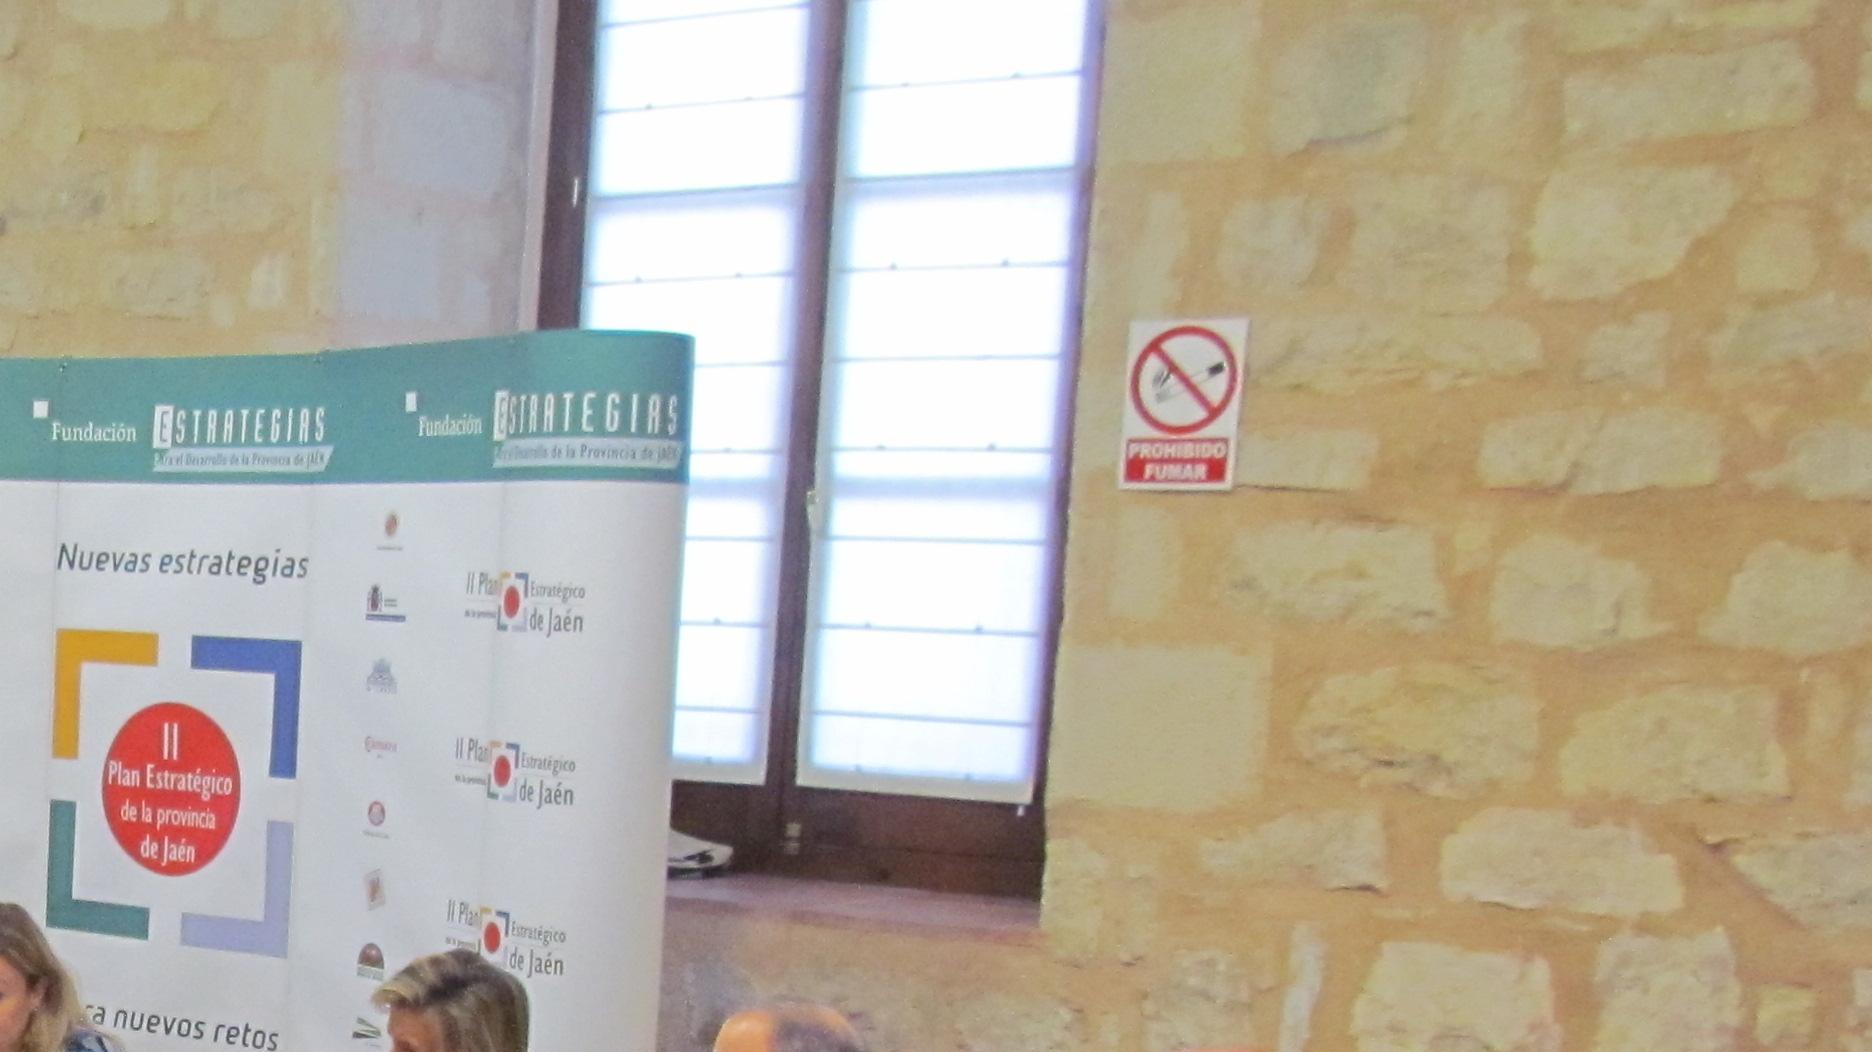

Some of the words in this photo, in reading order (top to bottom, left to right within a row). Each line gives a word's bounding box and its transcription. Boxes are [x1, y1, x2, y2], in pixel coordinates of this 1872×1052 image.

[51, 421, 138, 443] Fundación
[158, 407, 327, 444] ESTRATEGIAS
[418, 413, 482, 437] Fundación
[496, 391, 677, 435] ESTRATEGIAS
[1129, 442, 1227, 459] PROHIBIDO
[1142, 463, 1208, 480] FUMAR
[57, 542, 152, 573] Nuevas
[158, 548, 310, 585] estrategias
[478, 572, 503, 596] Plan
[530, 581, 586, 603] Estratégico
[529, 607, 544, 631] de
[546, 607, 584, 638] Jaén
[163, 722, 178, 760] II
[468, 738, 492, 763] Plan
[521, 752, 576, 776] Estratégico
[108, 760, 140, 787] Plan
[146, 763, 233, 801] Estratégico
[519, 778, 534, 802] de
[536, 779, 574, 810] Jaén
[120, 798, 137, 822] de
[142, 799, 152, 823] la
[157, 806, 216, 831] provincia
[140, 833, 158, 859] de
[162, 835, 196, 867] Jaén
[458, 901, 481, 926] Plan
[511, 920, 567, 946] Estratégico
[509, 946, 525, 971] de
[527, 948, 564, 979] Jaén
[113, 1007, 206, 1040] nuevos
[213, 1022, 279, 1052] retos
